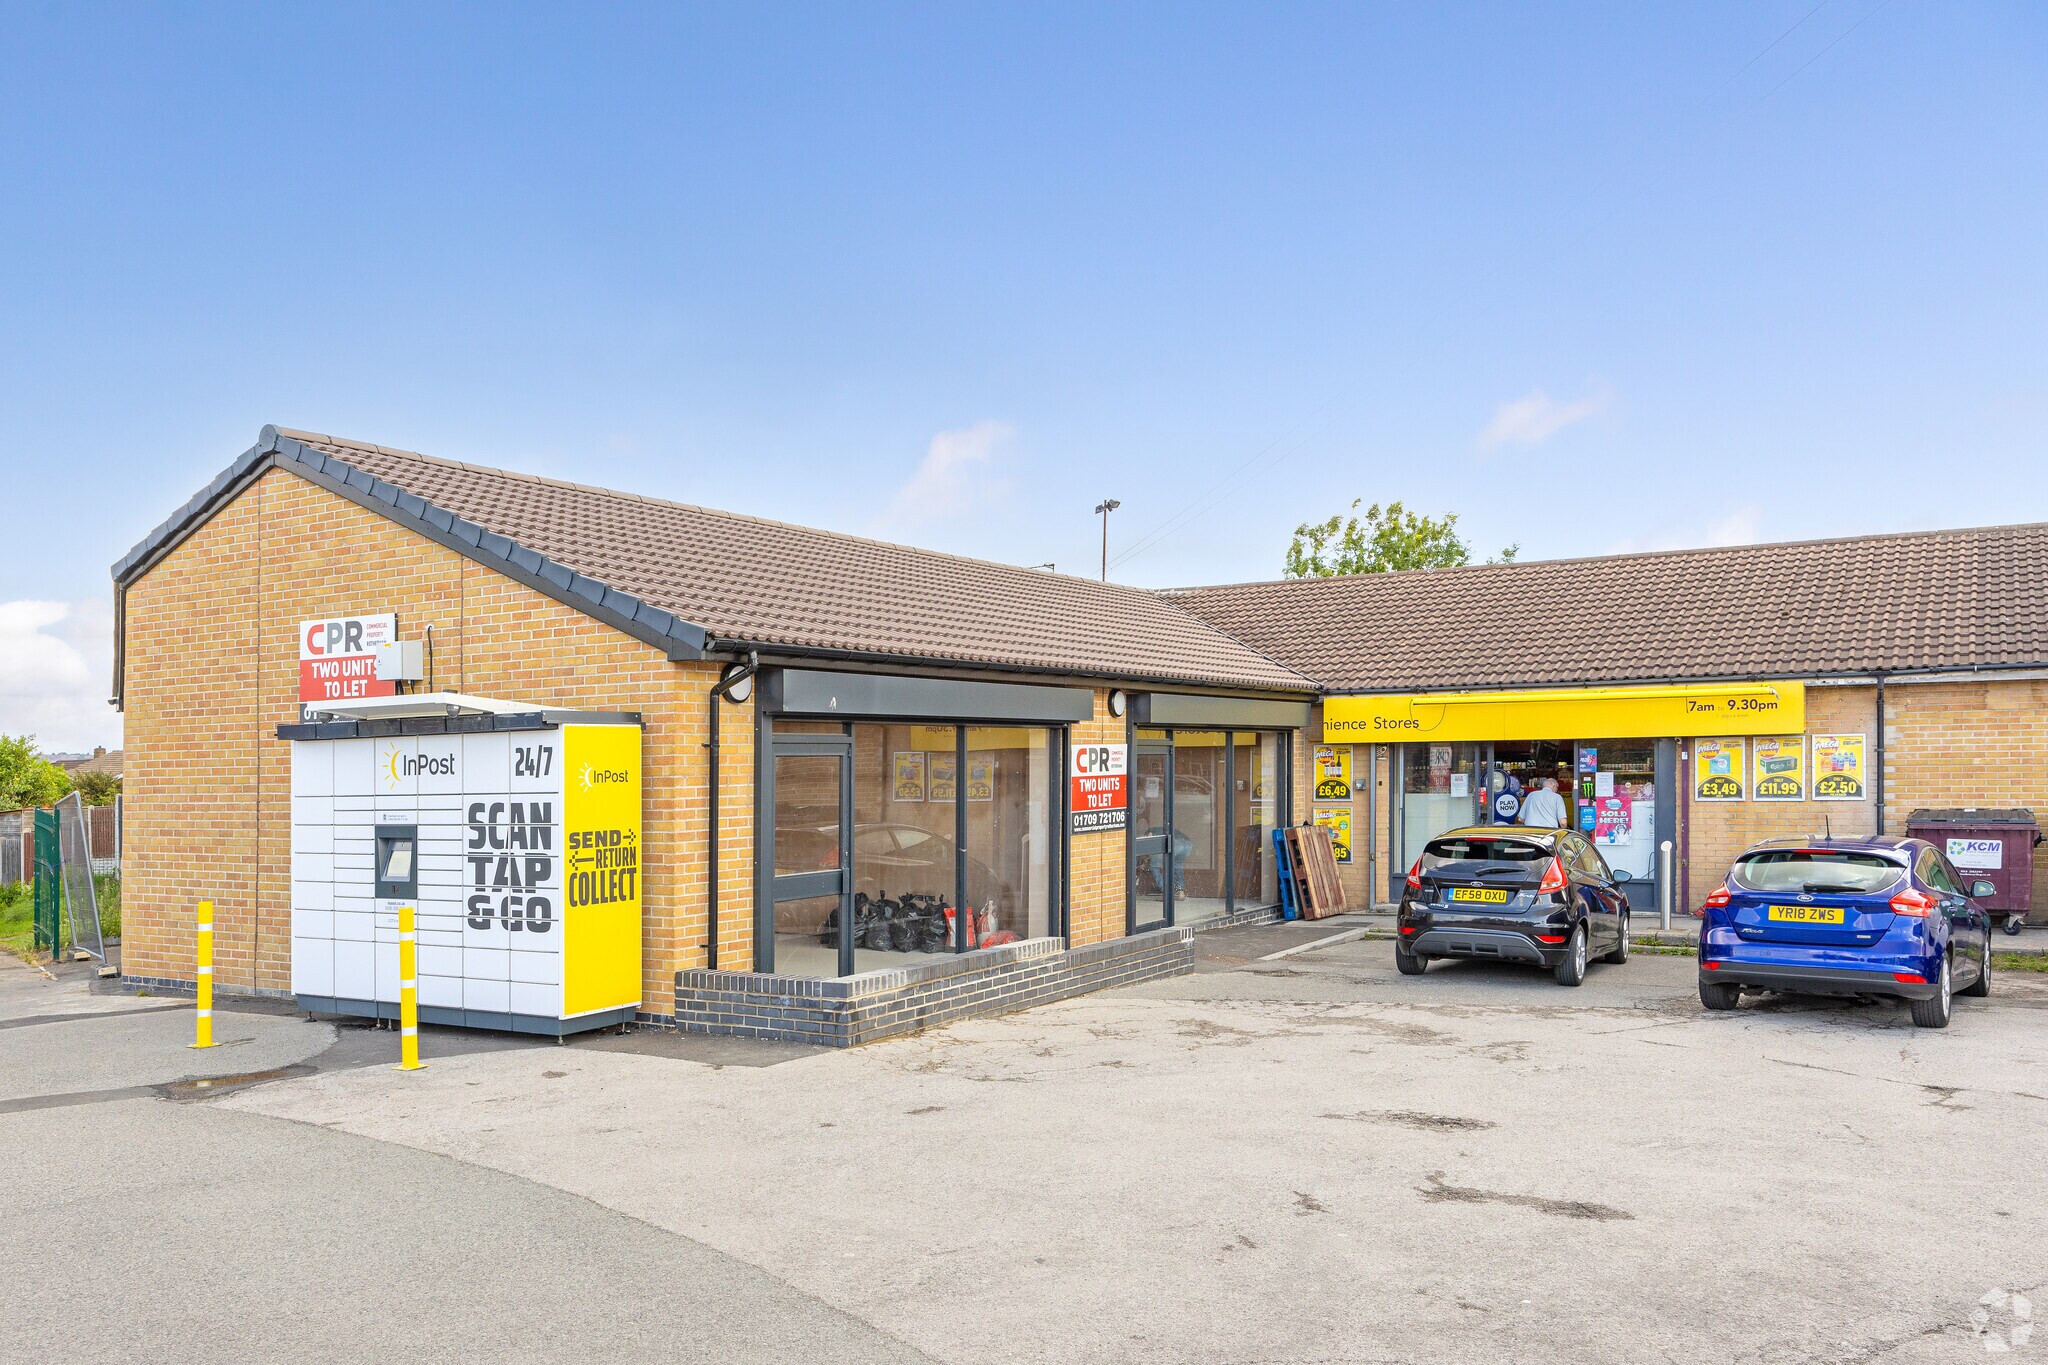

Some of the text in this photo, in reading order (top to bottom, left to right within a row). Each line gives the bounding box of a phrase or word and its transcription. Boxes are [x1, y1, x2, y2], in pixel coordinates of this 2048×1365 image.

[307, 620, 363, 655] CPR
[311, 661, 340, 679] TWO
[324, 679, 368, 698] TO LET
[1688, 700, 1715, 712] 7am
[1727, 698, 1778, 712] 9.30pm
[1373, 716, 1419, 730] Stores
[403, 753, 455, 776] InPost
[515, 744, 553, 778] 24/7
[1075, 747, 1110, 773] CPR
[593, 769, 629, 783] InPost
[1079, 777, 1120, 793] TWO UNITS
[1318, 785, 1347, 797] £6.49
[1702, 783, 1737, 795] £3.49
[1760, 782, 1798, 795] £11.99
[1819, 781, 1857, 794] £2.50
[1087, 793, 1113, 808] TO LET
[467, 802, 552, 850] SCAN
[1073, 810, 1126, 827] 01709 721706
[568, 829, 622, 850] SEND
[1966, 841, 2001, 852] KCM
[595, 846, 637, 869] RETURN
[467, 852, 552, 894] TAP
[568, 867, 637, 908] COLLECT
[1454, 889, 1506, 901] EF58 OXU
[467, 894, 552, 933] & GO
[1777, 907, 1835, 921] YR18 ZWS
